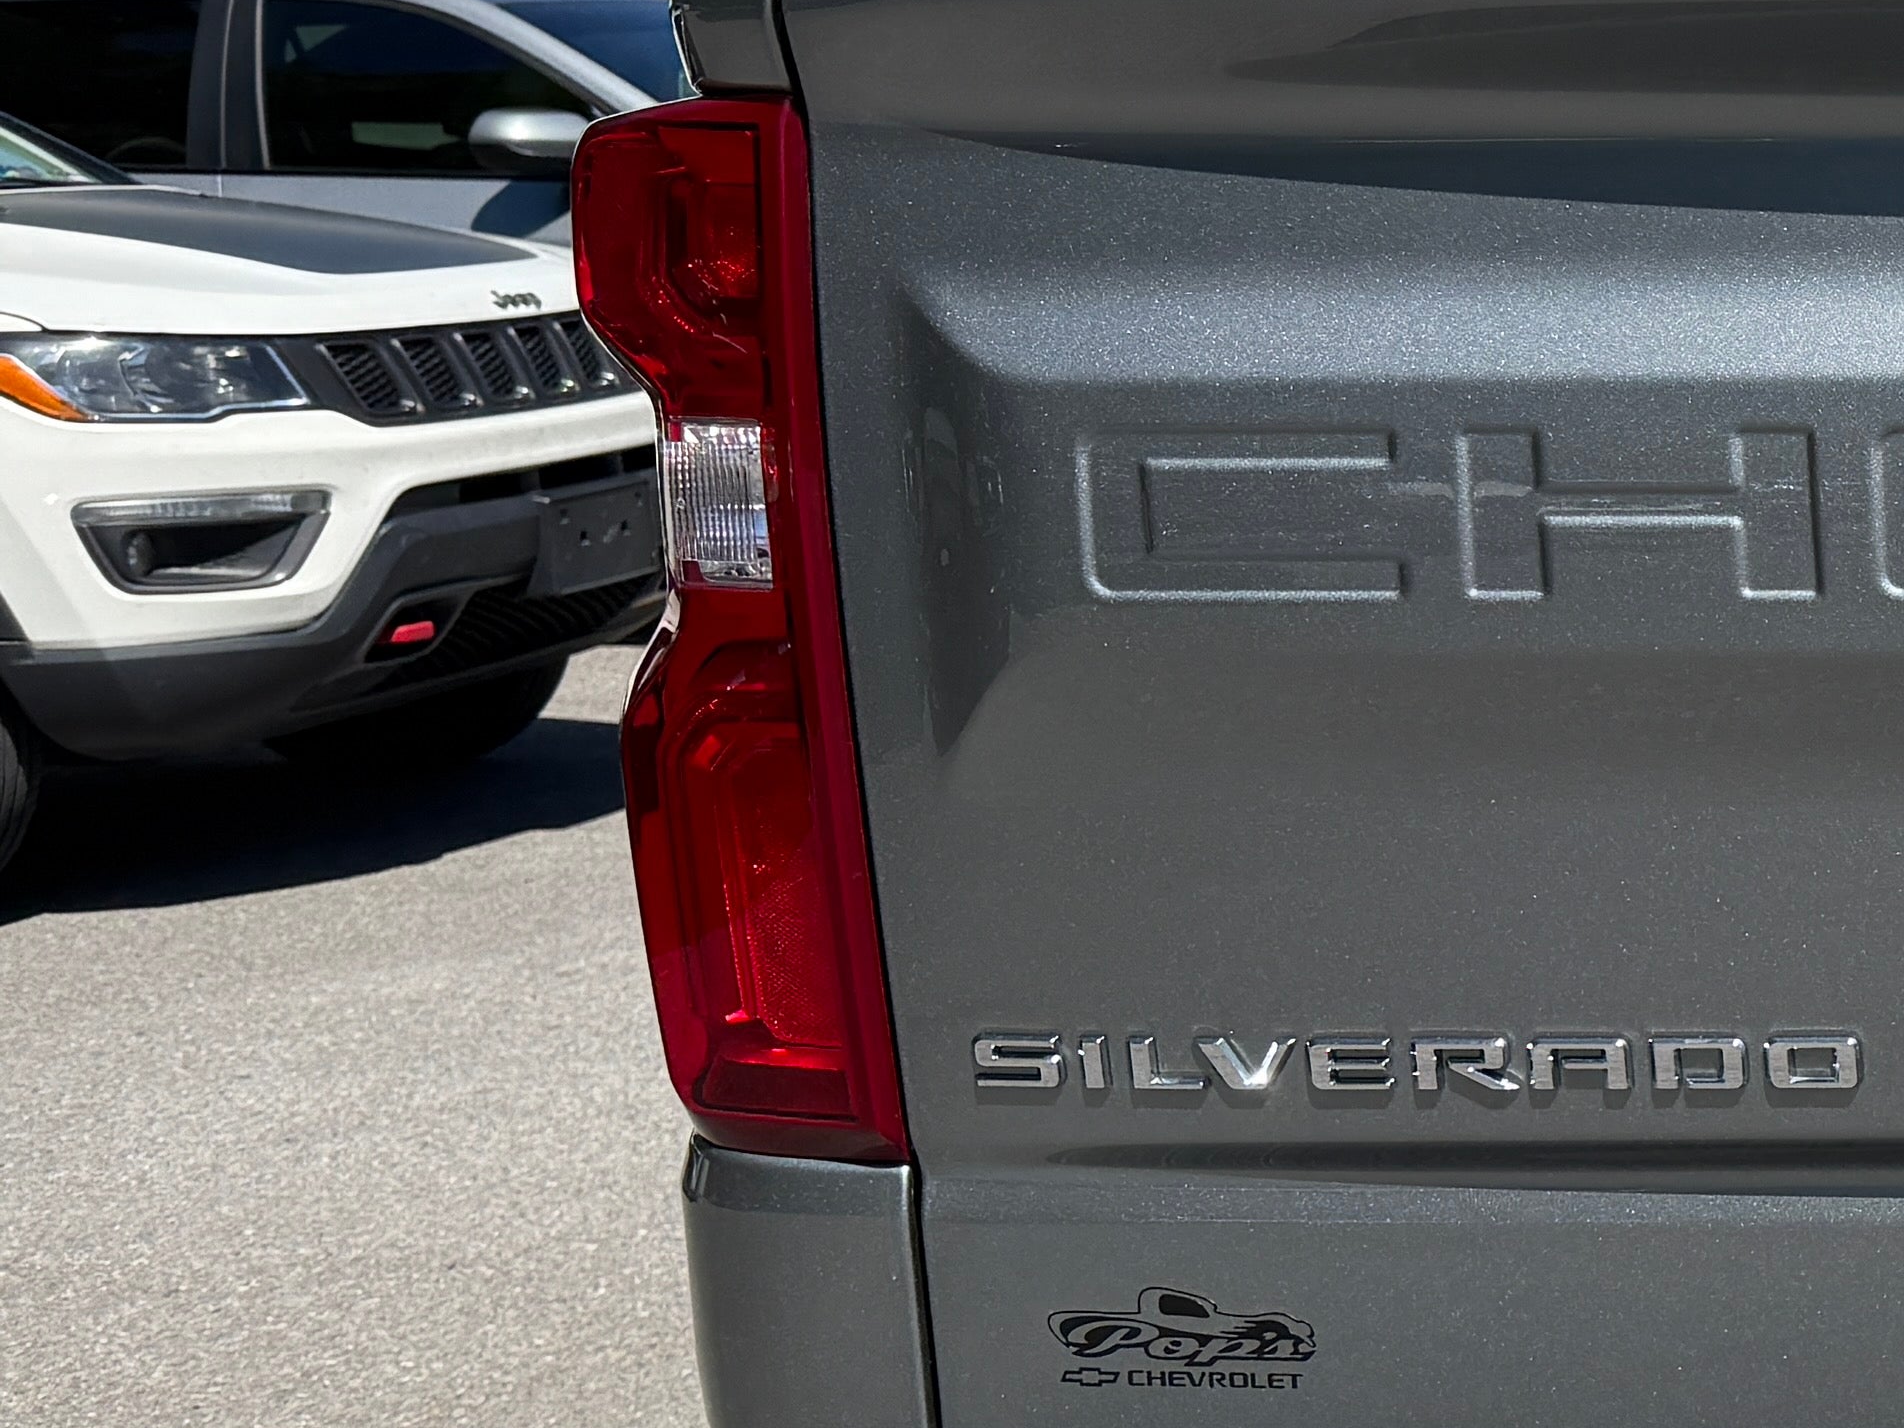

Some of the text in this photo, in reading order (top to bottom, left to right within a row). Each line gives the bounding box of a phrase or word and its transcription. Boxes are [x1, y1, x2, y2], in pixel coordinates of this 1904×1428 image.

[490, 290, 542, 309] Jeep
[972, 1032, 1861, 1093] SILVERADO
[1127, 1371, 1303, 1389] CHEVROLET
